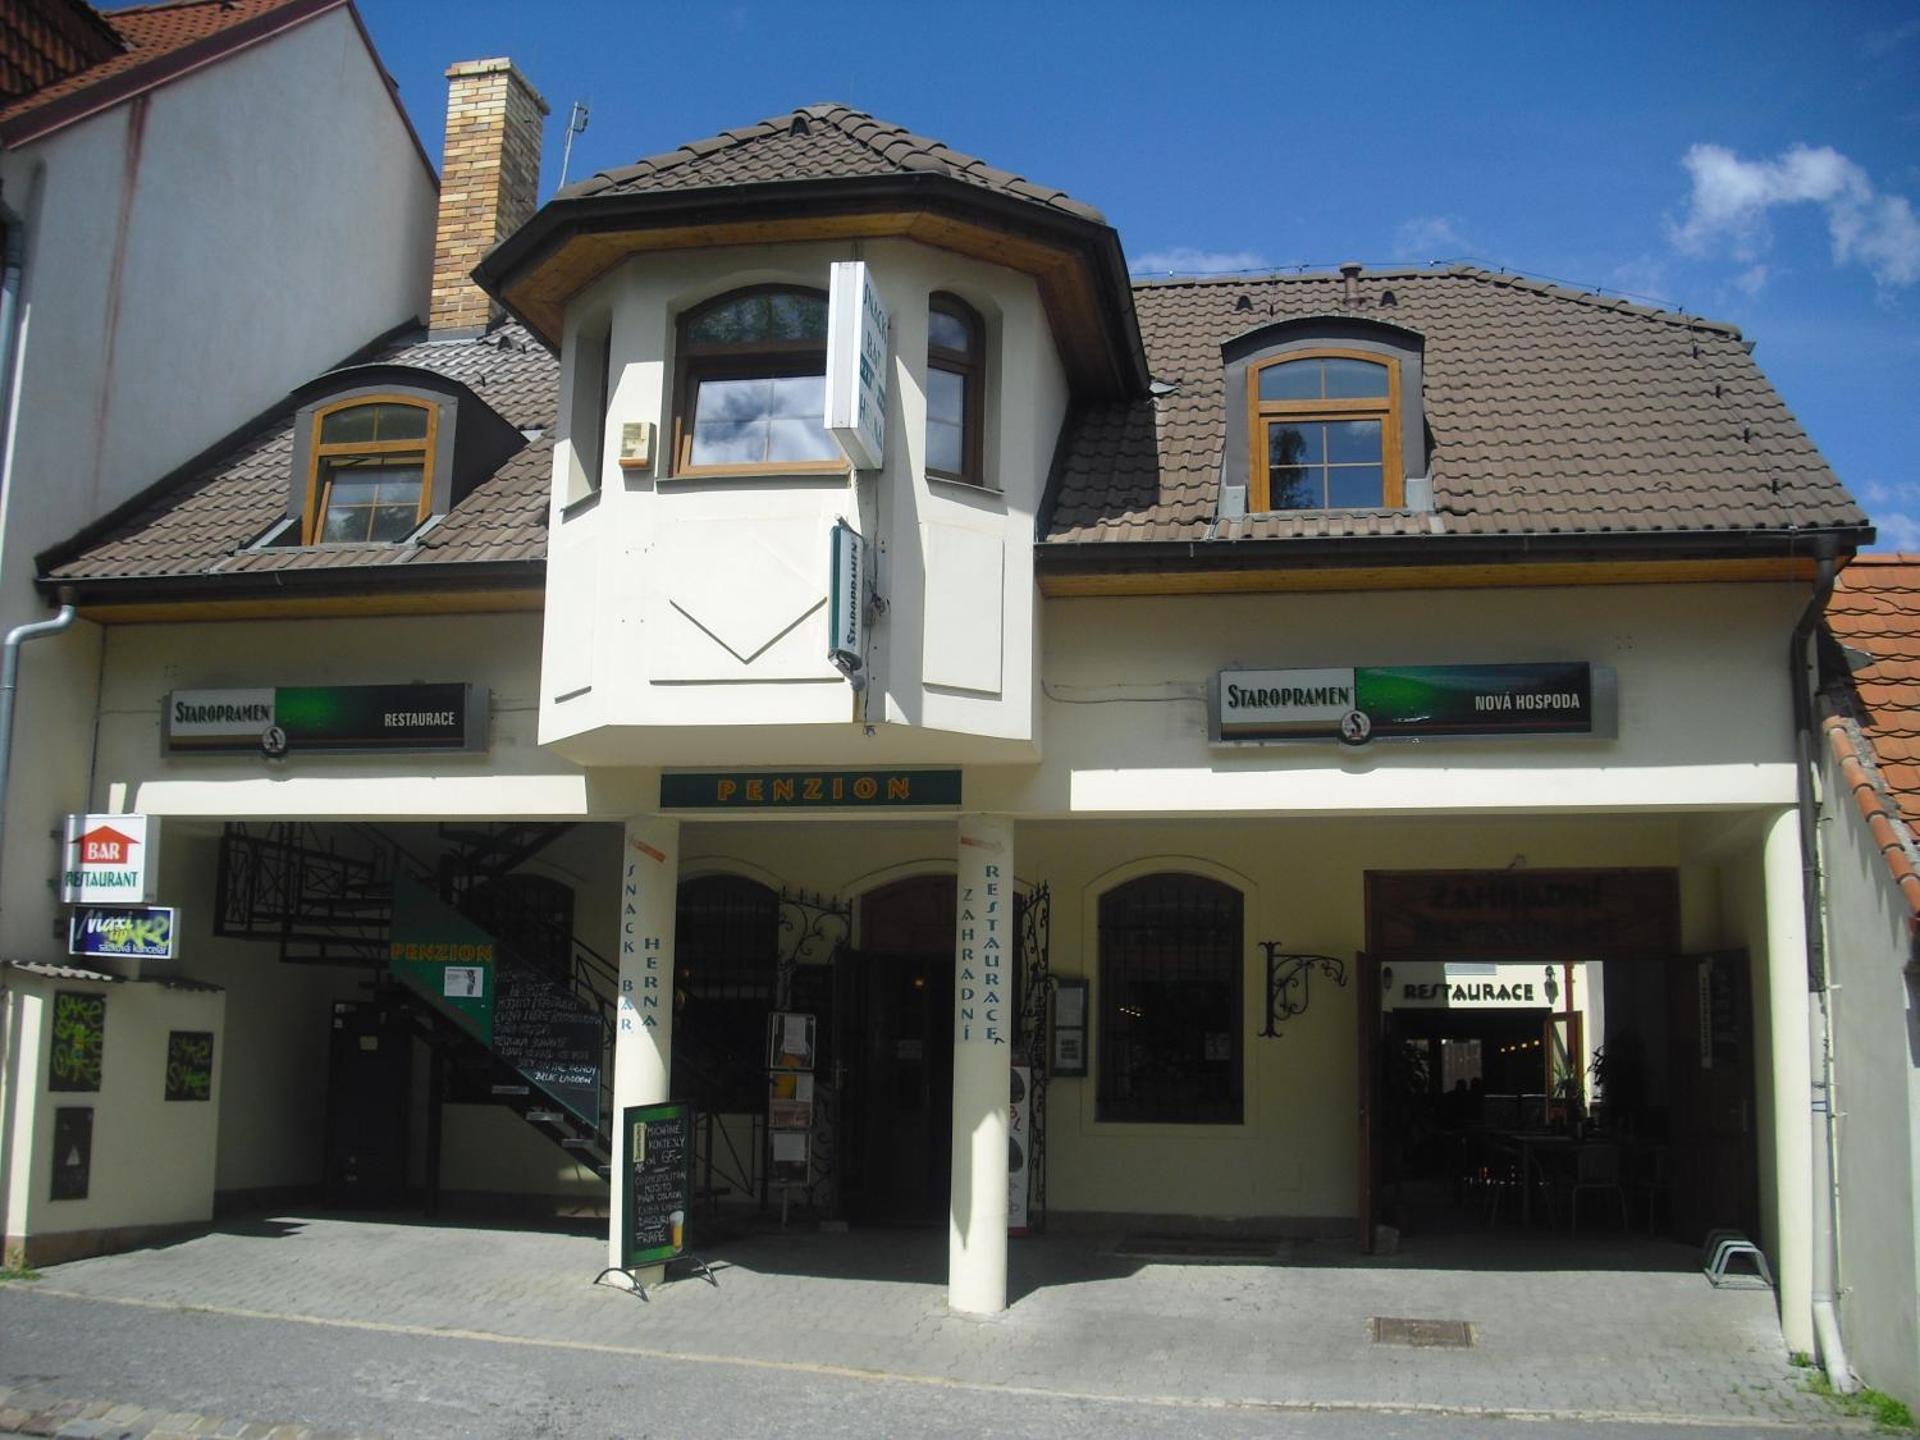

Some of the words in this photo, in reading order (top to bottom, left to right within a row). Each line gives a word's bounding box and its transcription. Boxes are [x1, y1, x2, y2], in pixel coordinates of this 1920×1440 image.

[1227, 683, 1349, 708] STAROPRAMEN
[1475, 691, 1513, 711] NOVÁ
[1516, 693, 1580, 710] HOSPODA
[175, 701, 270, 723] STAROPRAMEN
[384, 711, 455, 727] RESTAURACE
[718, 777, 911, 801] PENZION
[88, 843, 120, 860] BAR
[65, 871, 138, 888] RESTAURANT
[624, 865, 637, 953] SNACK
[390, 944, 493, 961] PENZION
[984, 865, 1000, 1040] RESTAURACE
[961, 888, 975, 1041] ZAHRADNÍ
[643, 937, 659, 1027] HERNA
[1404, 983, 1534, 1001] RESTAURACE
[621, 979, 633, 1031] BAR
